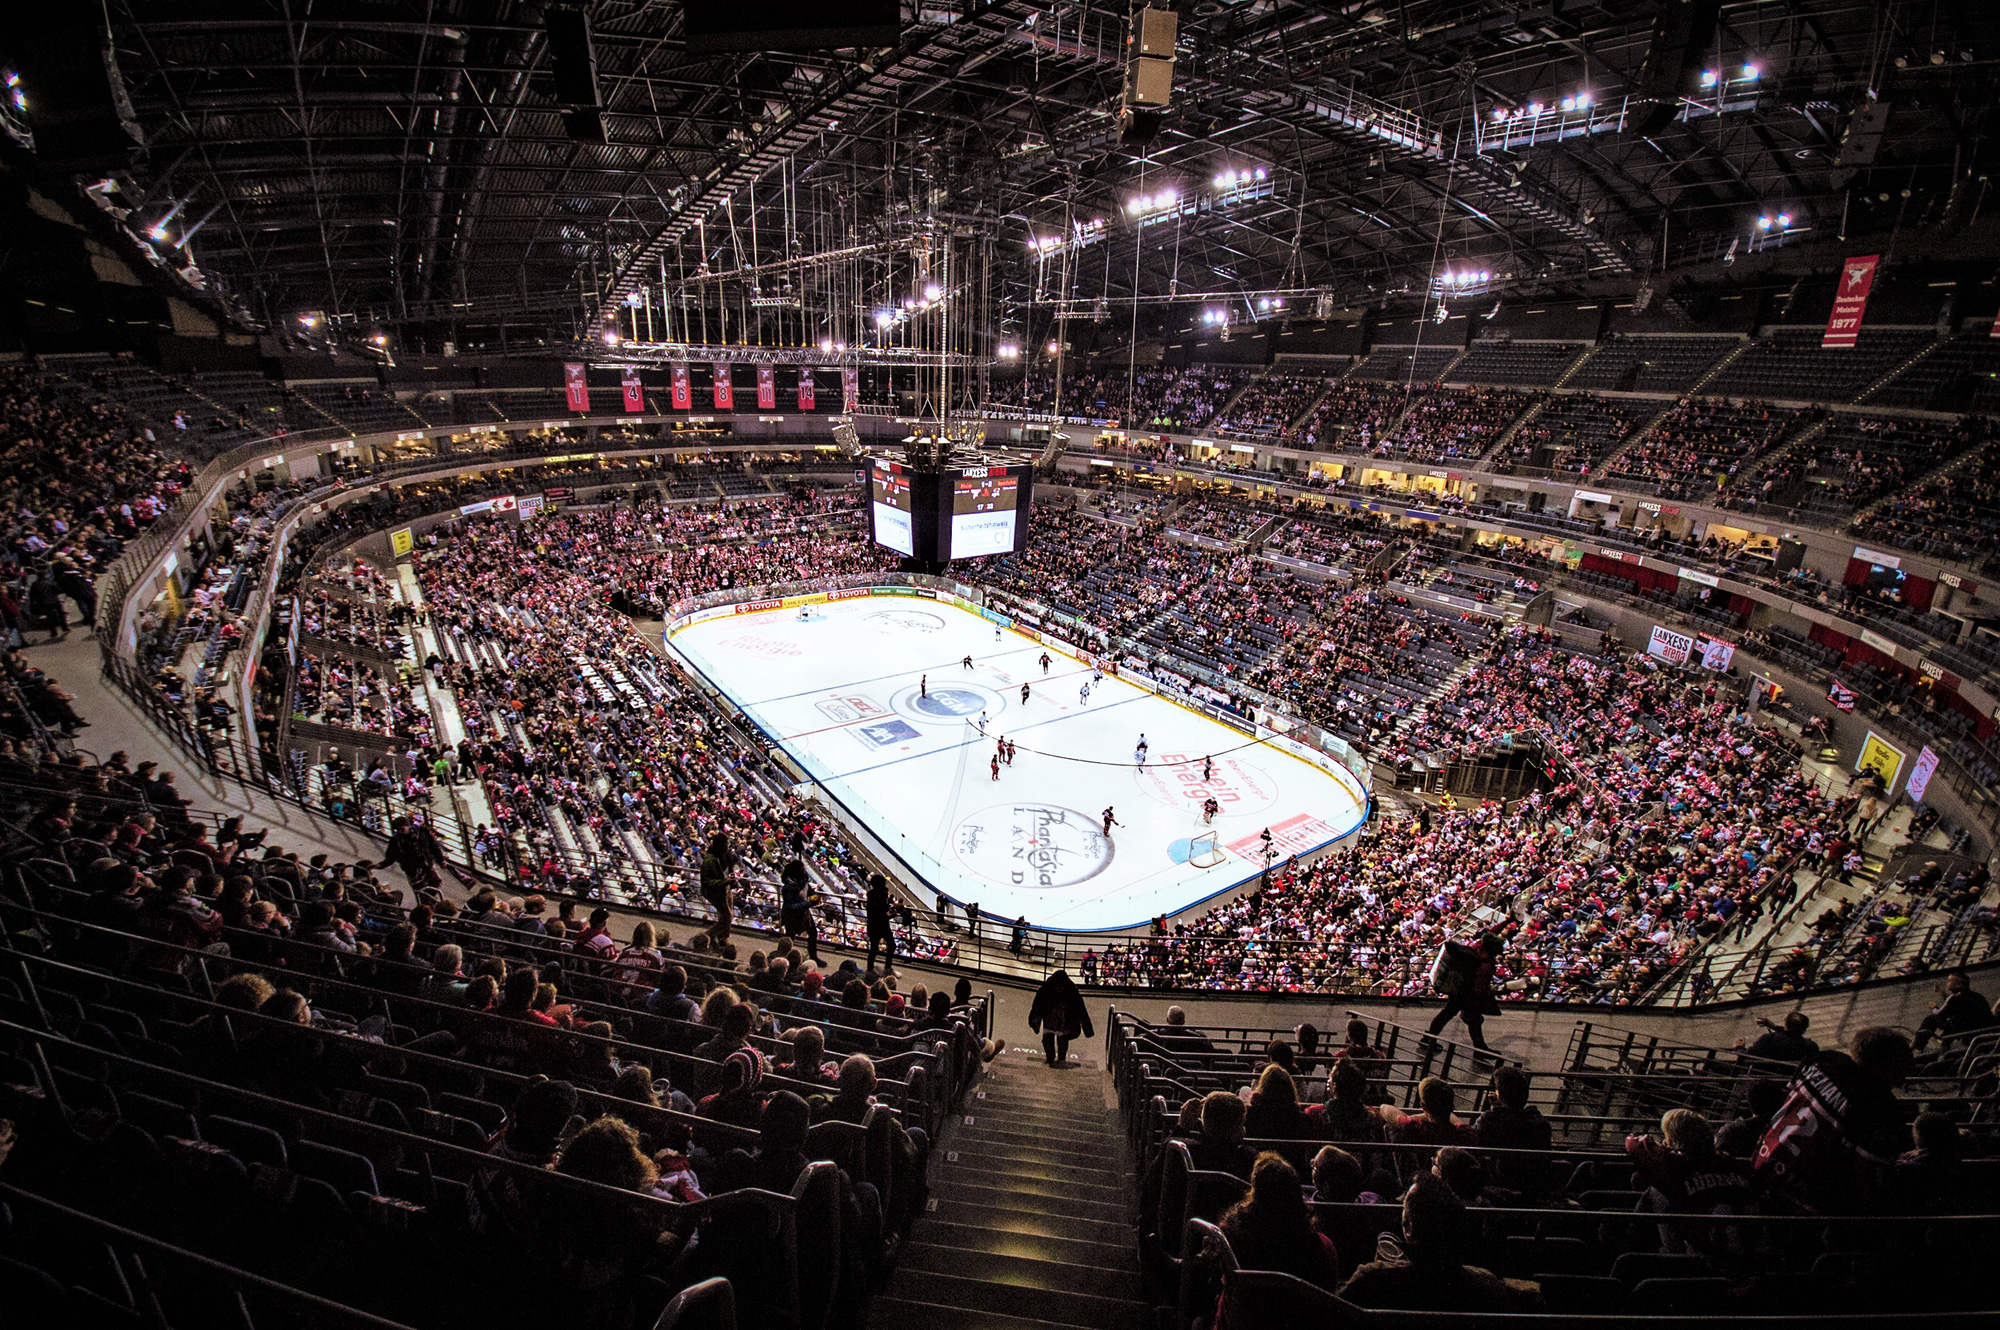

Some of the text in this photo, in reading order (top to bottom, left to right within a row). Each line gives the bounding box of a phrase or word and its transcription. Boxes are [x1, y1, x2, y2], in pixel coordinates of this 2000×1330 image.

[1836, 295, 1866, 303] Deutscher
[1831, 318, 1857, 329] 1977
[573, 388, 581, 404] 1
[628, 385, 639, 401] 4
[677, 387, 686, 402] 6
[719, 387, 728, 402] 8
[760, 388, 773, 402] 11
[800, 385, 813, 400] 14
[963, 466, 988, 478] LANXESS
[1638, 501, 1661, 511] LANXESS
[1601, 549, 1623, 560] LANXESS
[1939, 571, 1962, 588] LANXESS
[750, 601, 781, 611] TOYOTA
[840, 589, 869, 598] TOYOTA
[1654, 627, 1690, 652] LANXESS
[1663, 646, 1686, 661] arena
[1920, 660, 1944, 681] LANXESS
[931, 692, 973, 714] CGM
[1875, 746, 1890, 761] Radio
[1192, 757, 1241, 803] Rhein
